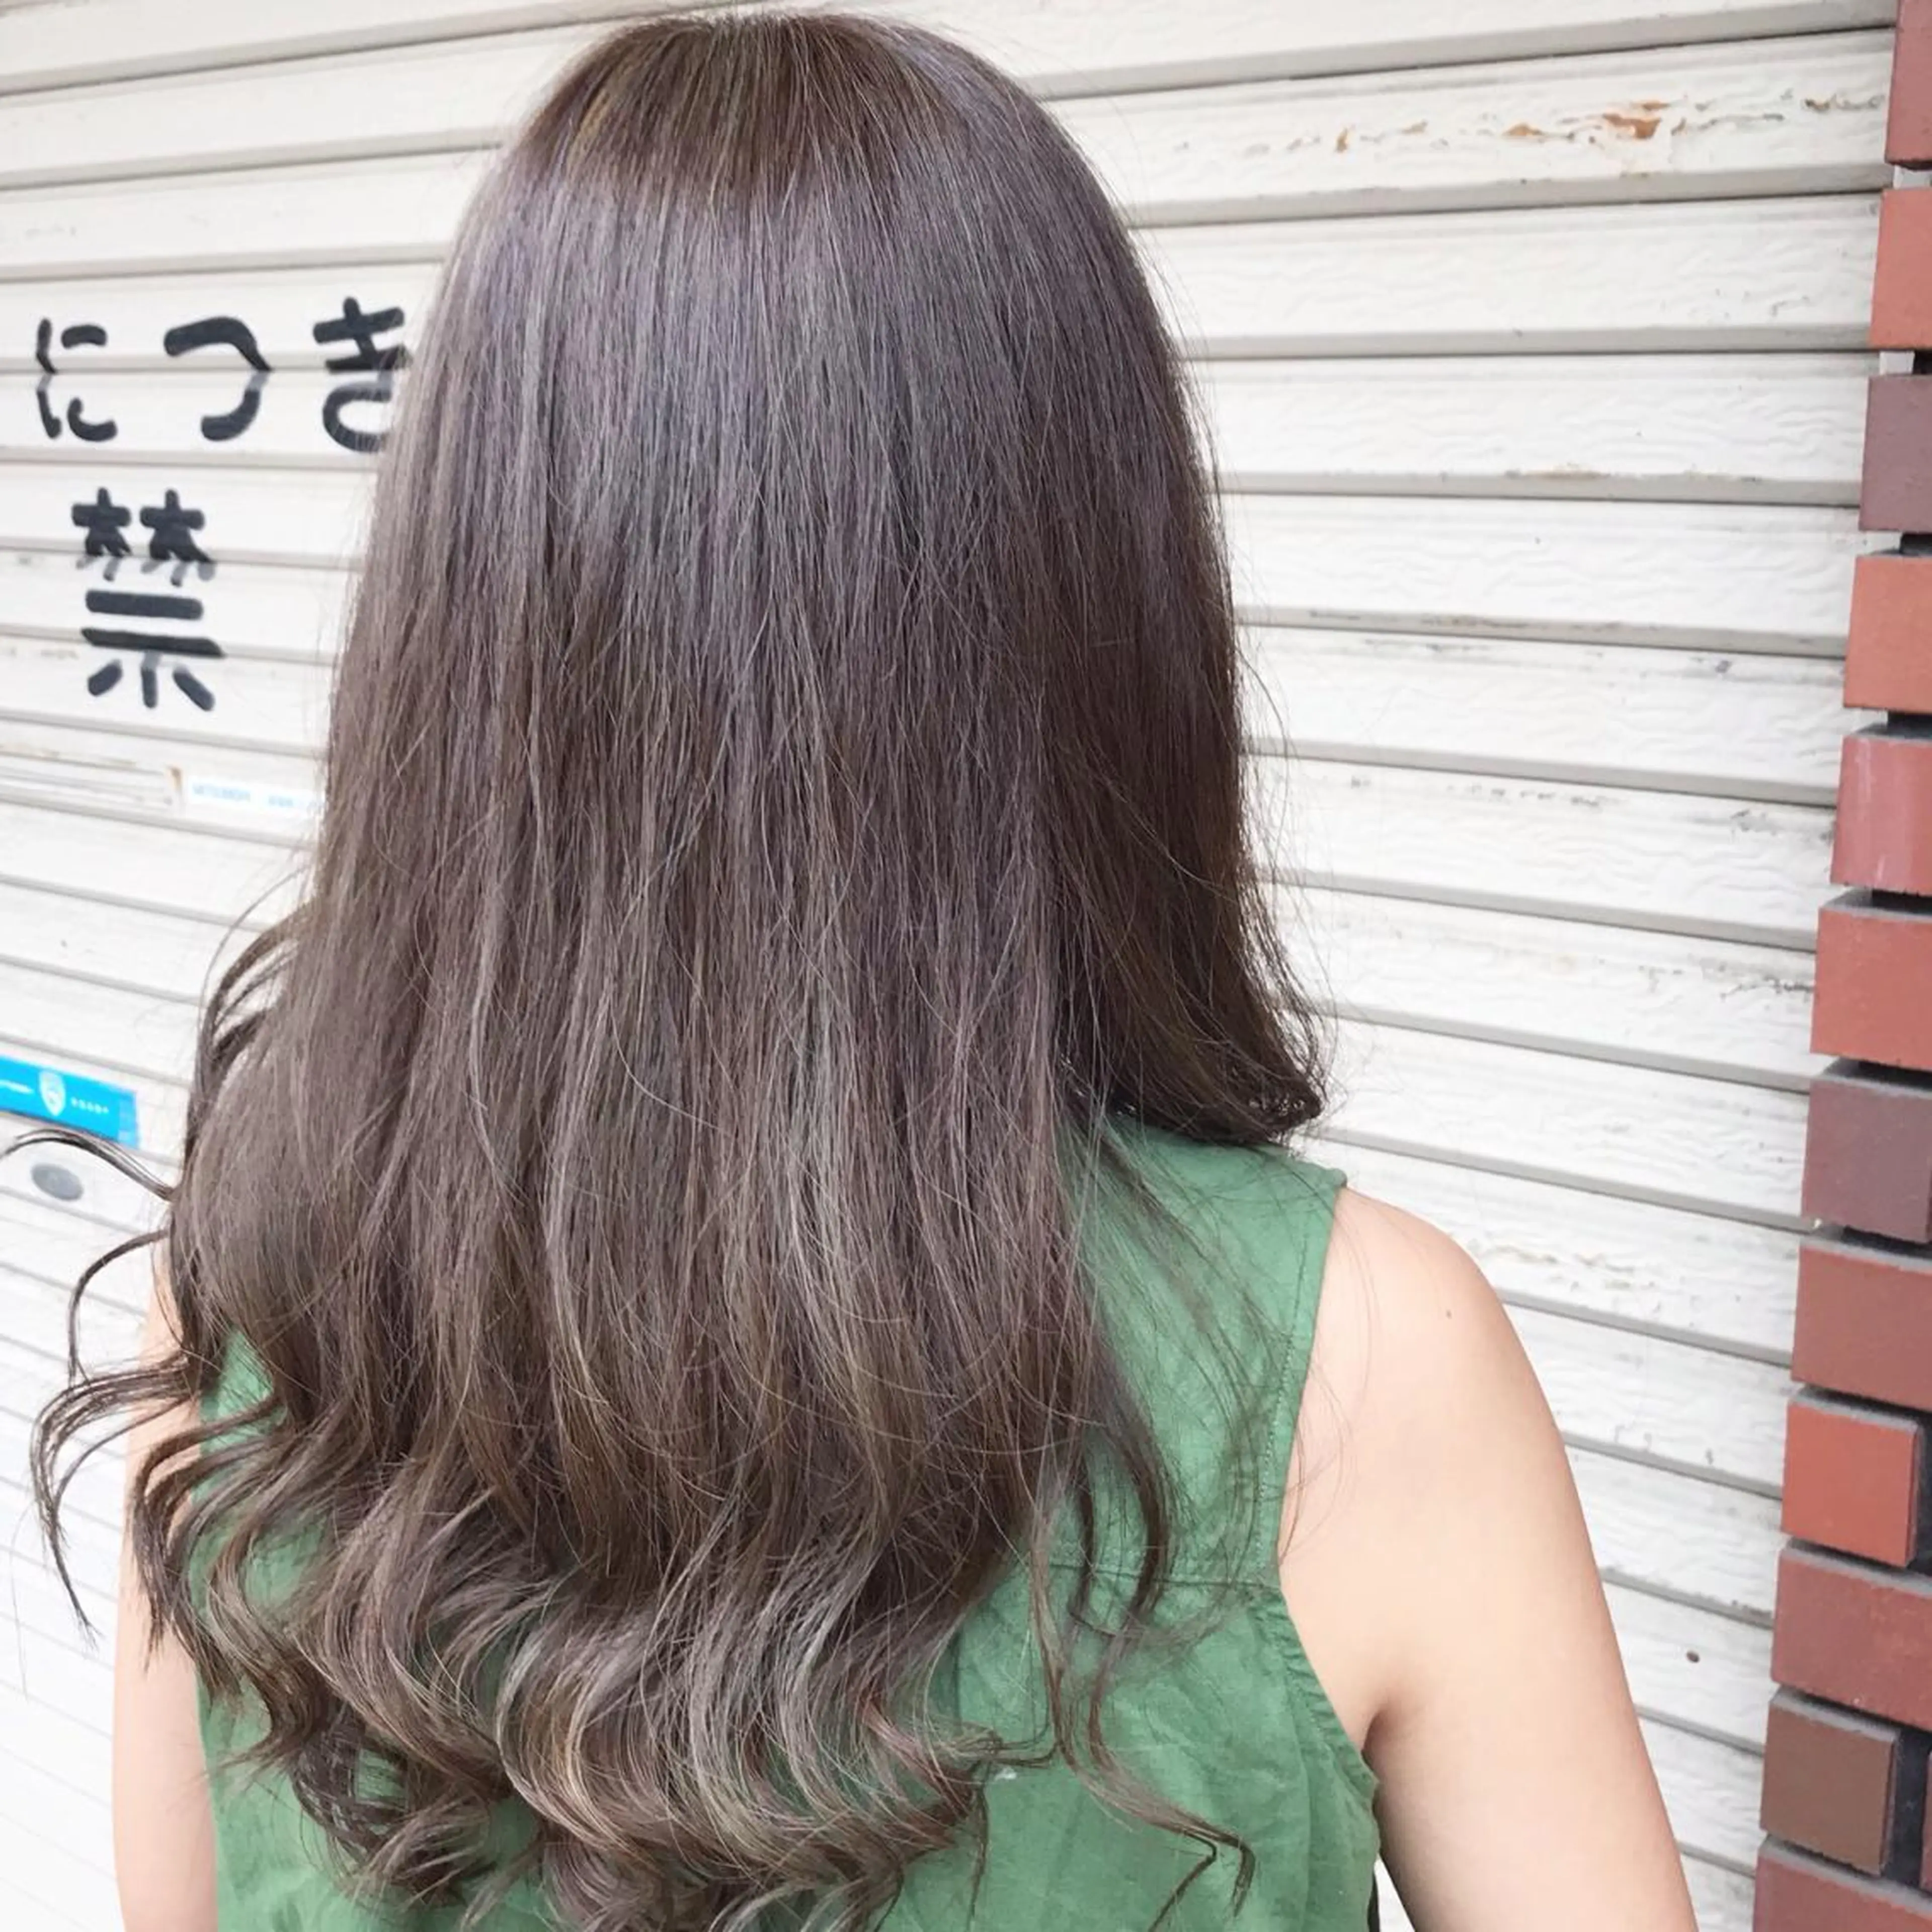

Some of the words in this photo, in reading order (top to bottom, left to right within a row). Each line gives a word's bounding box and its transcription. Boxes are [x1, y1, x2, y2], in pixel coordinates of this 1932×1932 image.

[37, 297, 410, 452] につき
[71, 487, 226, 711] 禁
